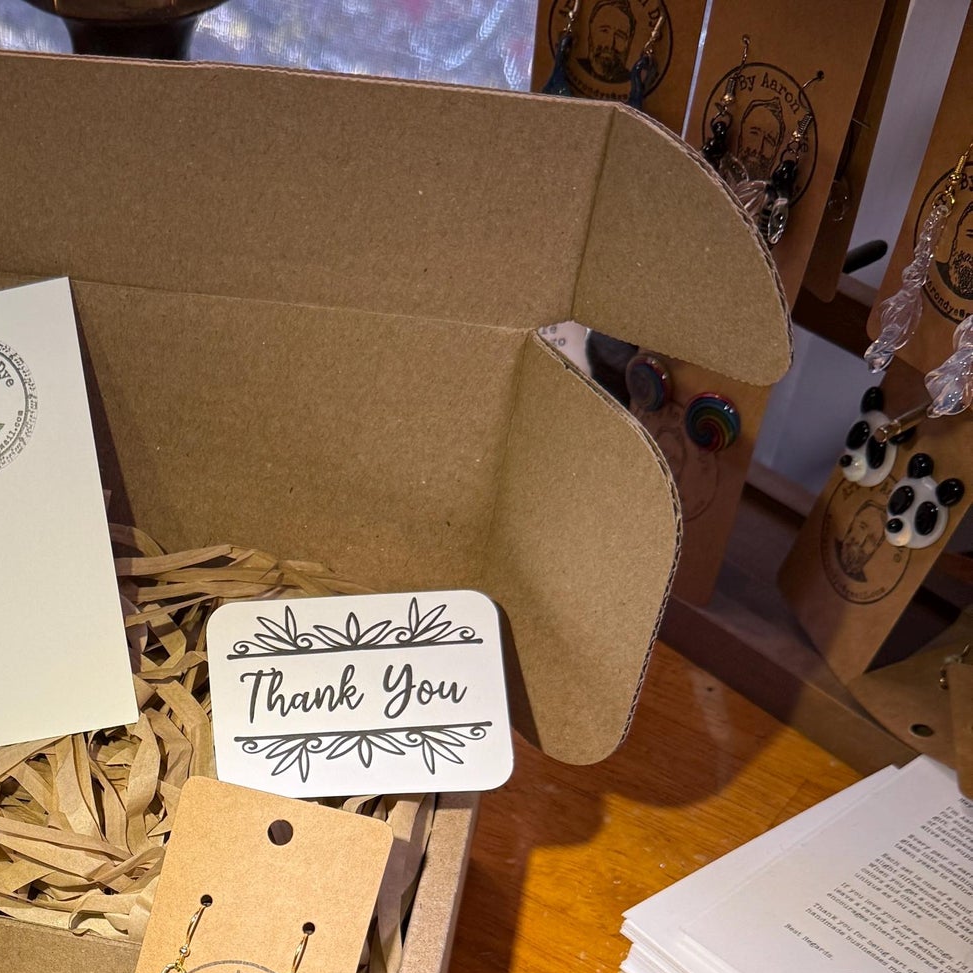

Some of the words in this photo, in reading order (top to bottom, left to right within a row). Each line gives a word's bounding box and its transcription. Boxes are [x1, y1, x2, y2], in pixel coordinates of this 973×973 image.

[738, 74, 756, 91] By
[760, 72, 801, 114] Aaron
[239, 664, 365, 724] Thank
[382, 663, 468, 720] You
